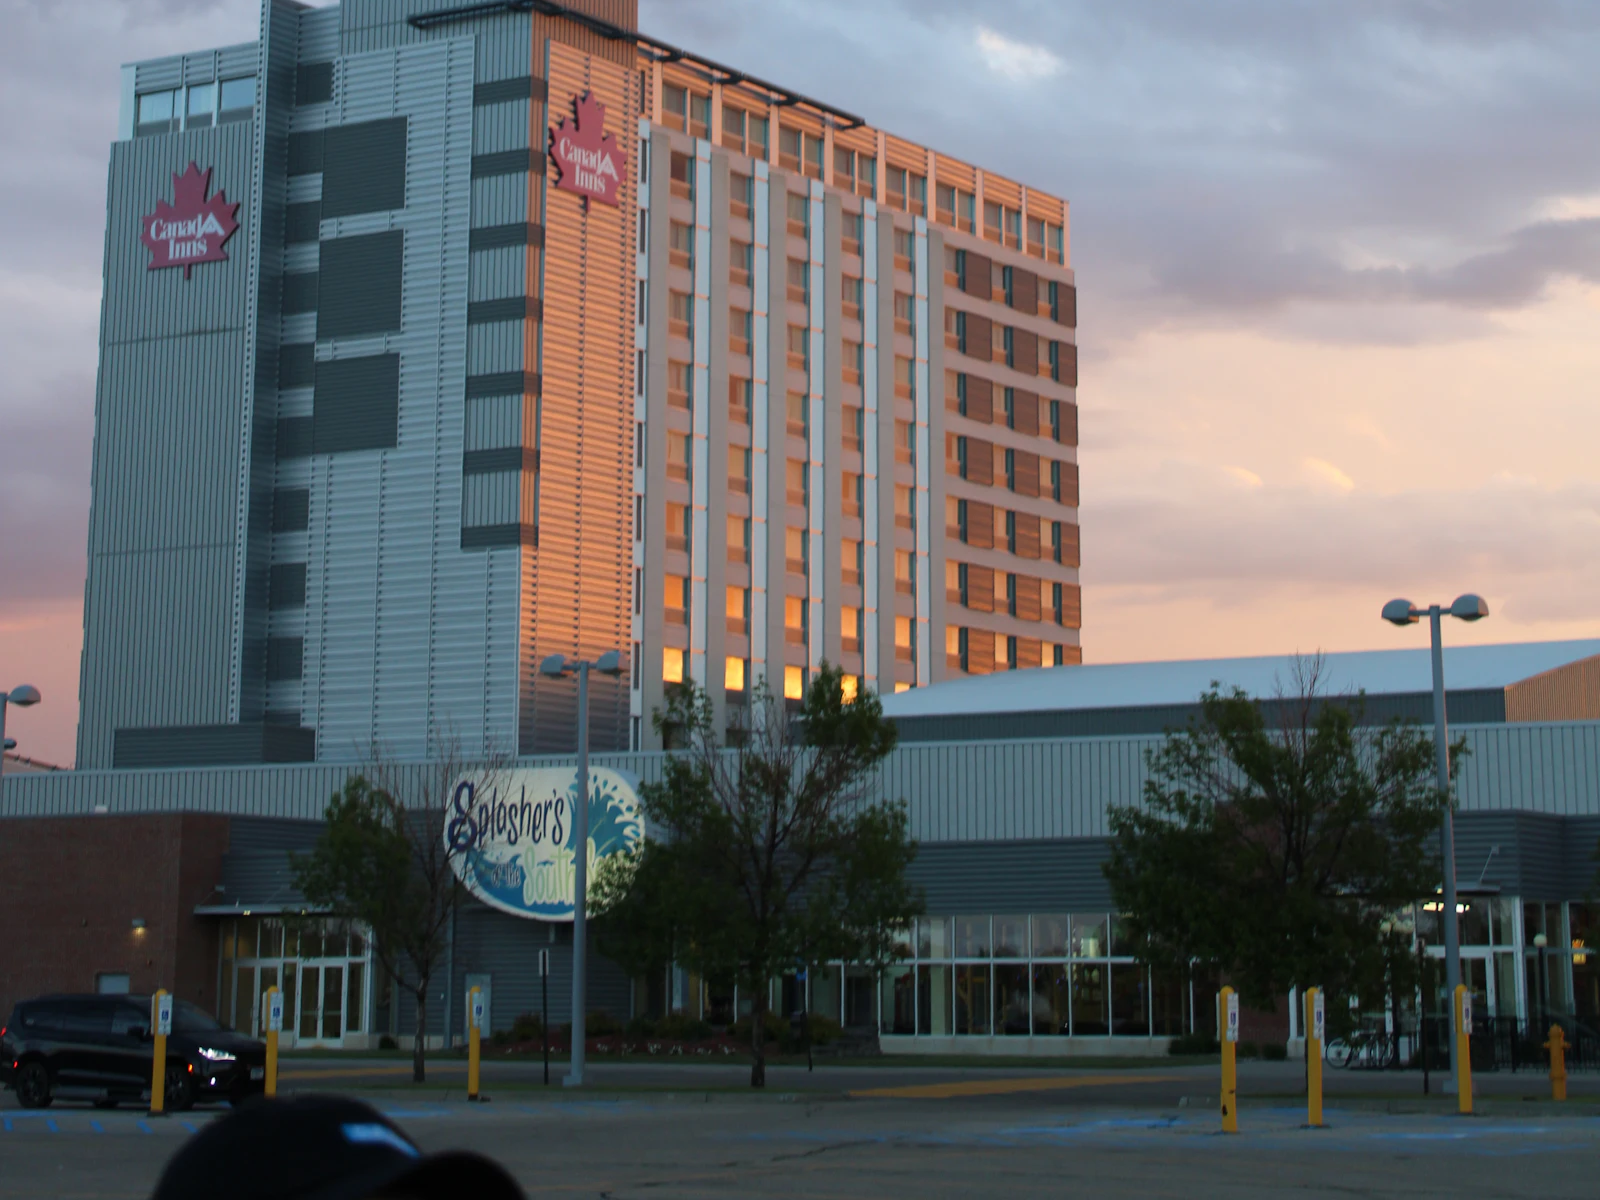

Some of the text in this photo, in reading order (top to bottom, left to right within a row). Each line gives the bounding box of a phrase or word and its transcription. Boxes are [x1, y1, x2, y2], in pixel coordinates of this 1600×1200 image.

[575, 164, 606, 194] Inns
[168, 237, 208, 261] Inns
[448, 780, 565, 851] Splasher's
[506, 861, 521, 888] the
